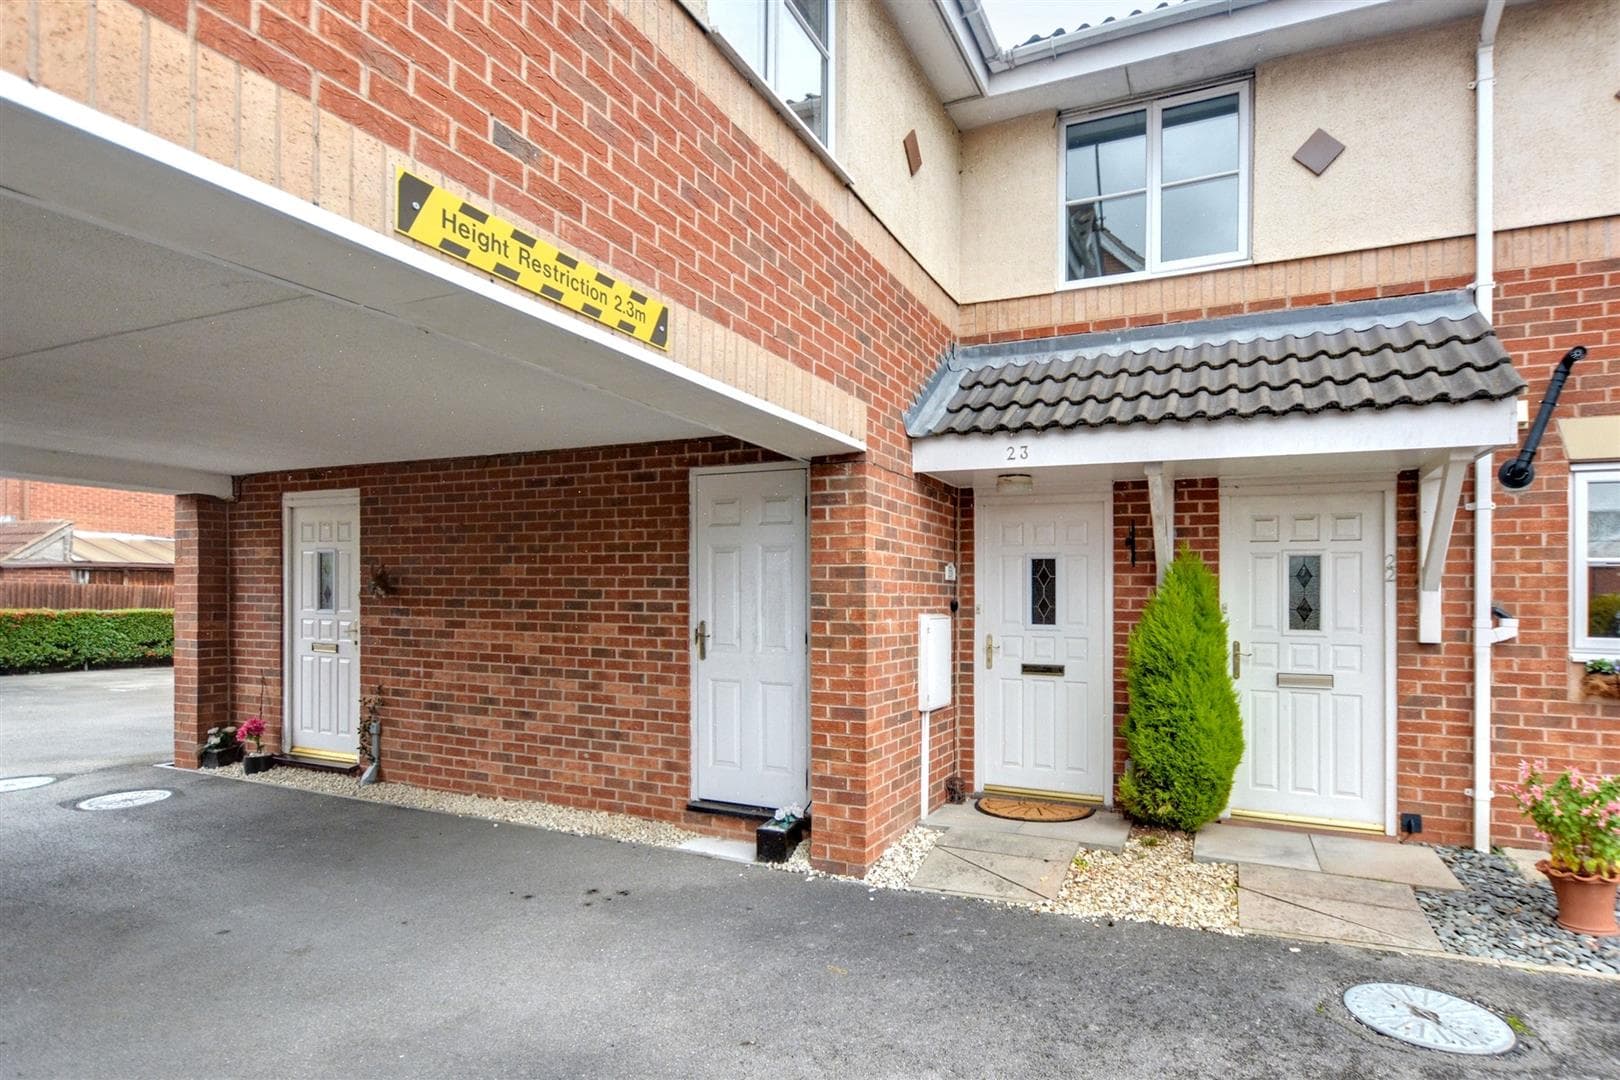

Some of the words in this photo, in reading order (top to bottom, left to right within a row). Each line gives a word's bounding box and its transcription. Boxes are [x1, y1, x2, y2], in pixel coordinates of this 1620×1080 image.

[442, 208, 509, 259] Height
[518, 248, 608, 305] Restriction
[614, 295, 647, 323] 2.3m
[1006, 445, 1029, 461] 23
